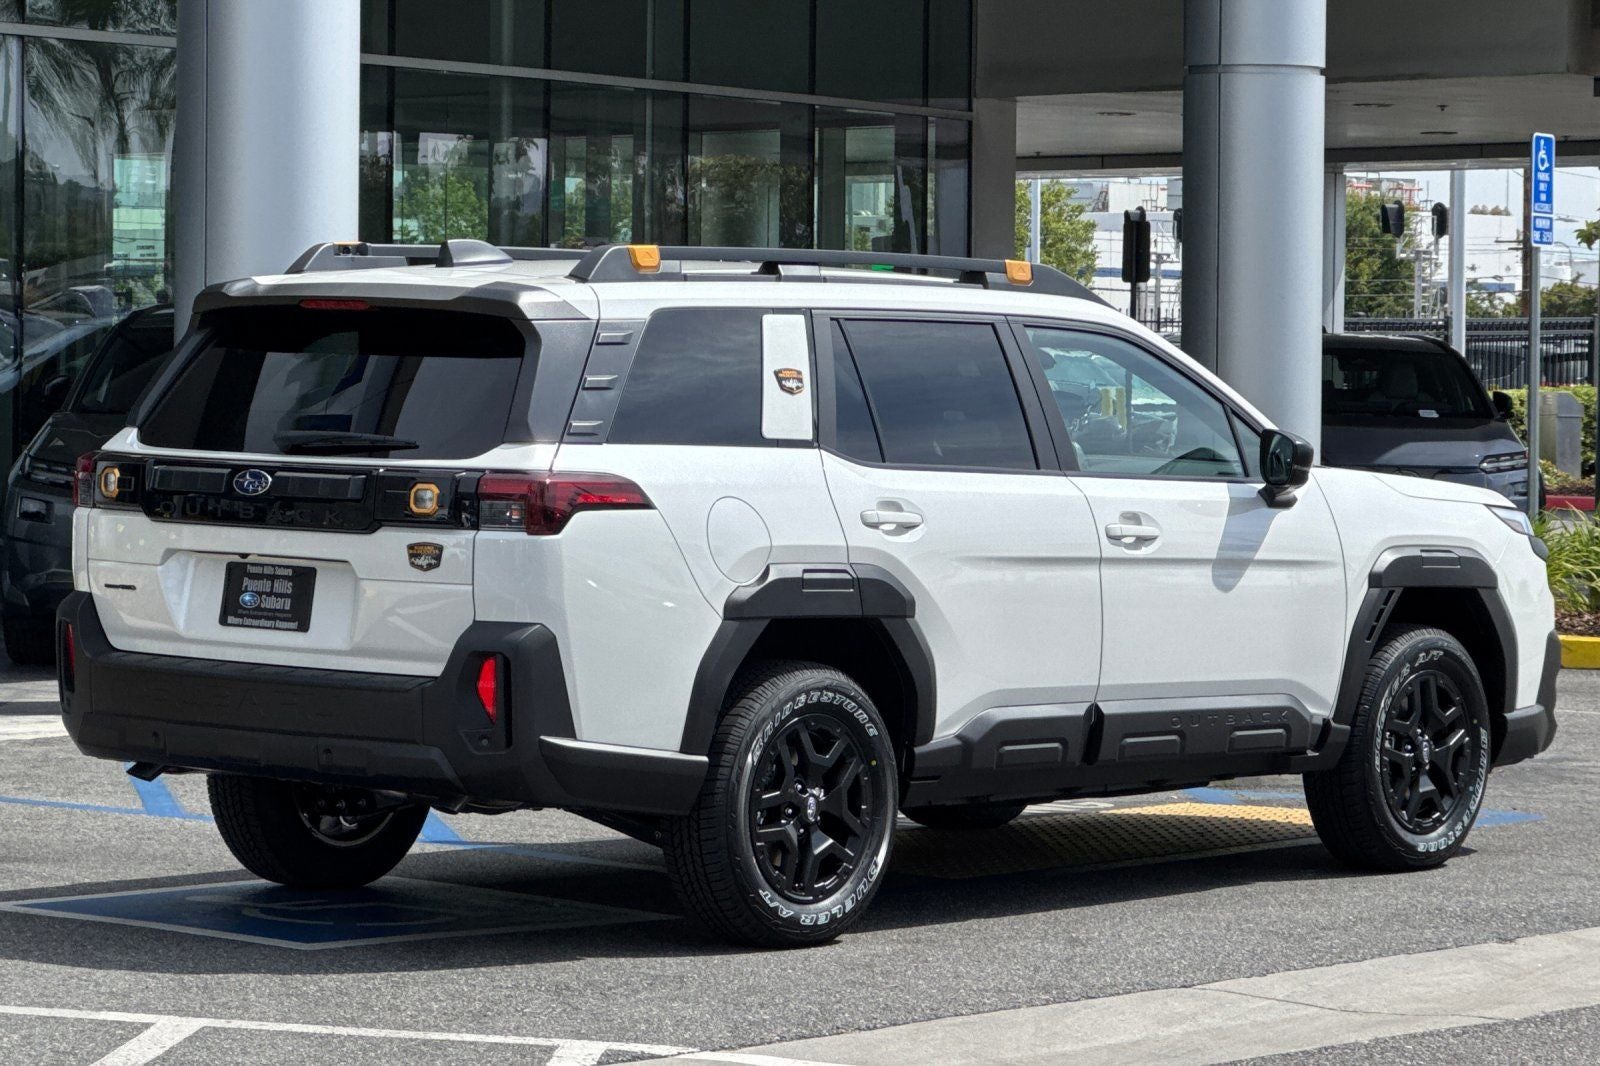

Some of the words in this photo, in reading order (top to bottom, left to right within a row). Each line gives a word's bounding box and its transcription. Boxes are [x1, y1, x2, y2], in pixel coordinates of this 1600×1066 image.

[159, 499, 343, 524] OUTBACK
[275, 566, 293, 576] Subaru
[242, 577, 272, 592] Puente
[273, 578, 293, 594] Hills
[260, 594, 291, 610] Subaru
[753, 690, 878, 766] BRIDGESTONE
[1171, 711, 1288, 729] OUTBACK
